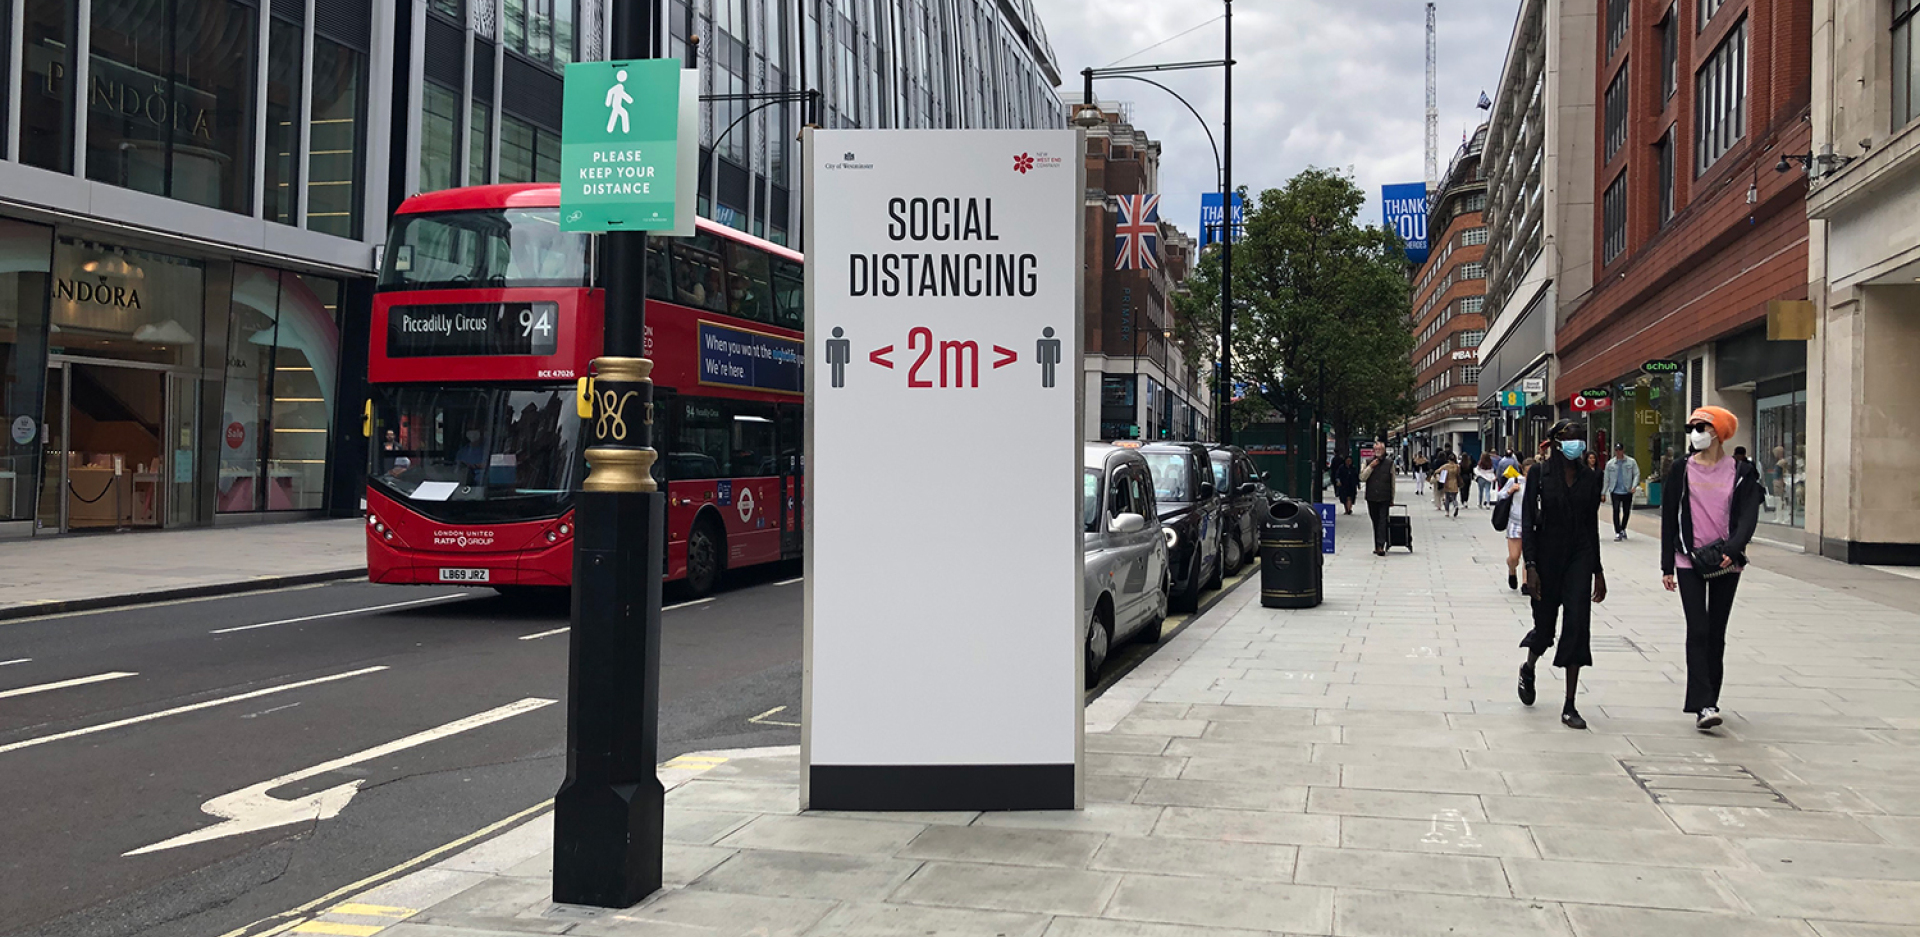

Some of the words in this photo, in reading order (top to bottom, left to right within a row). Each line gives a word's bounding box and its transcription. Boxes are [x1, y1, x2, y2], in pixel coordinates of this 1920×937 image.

[48, 60, 213, 140] PNDORA
[593, 151, 641, 162] PLEASE
[580, 168, 612, 179] KEEP
[617, 166, 655, 178] YOUR
[583, 183, 650, 195] DISTANCE
[1384, 198, 1426, 214] THANK
[888, 198, 999, 240] SOCIAL
[1387, 214, 1426, 240] YOU
[850, 254, 1037, 296] DISTANCING
[53, 276, 141, 309] NDORA
[402, 314, 452, 336] Piccadilly
[455, 314, 488, 331] Circus
[519, 309, 551, 337] 94
[705, 333, 728, 352] When
[728, 341, 741, 356] you
[742, 343, 760, 358] want
[761, 345, 772, 359] the
[908, 326, 979, 388] 2m
[552, 370, 574, 378] 47026
[706, 358, 728, 376] We're
[1646, 362, 1678, 370] schuh
[686, 404, 695, 418] 94
[228, 428, 244, 438] Sale
[466, 538, 494, 546] GROUP
[442, 570, 466, 580] LB69
[468, 570, 486, 580] JRZ
